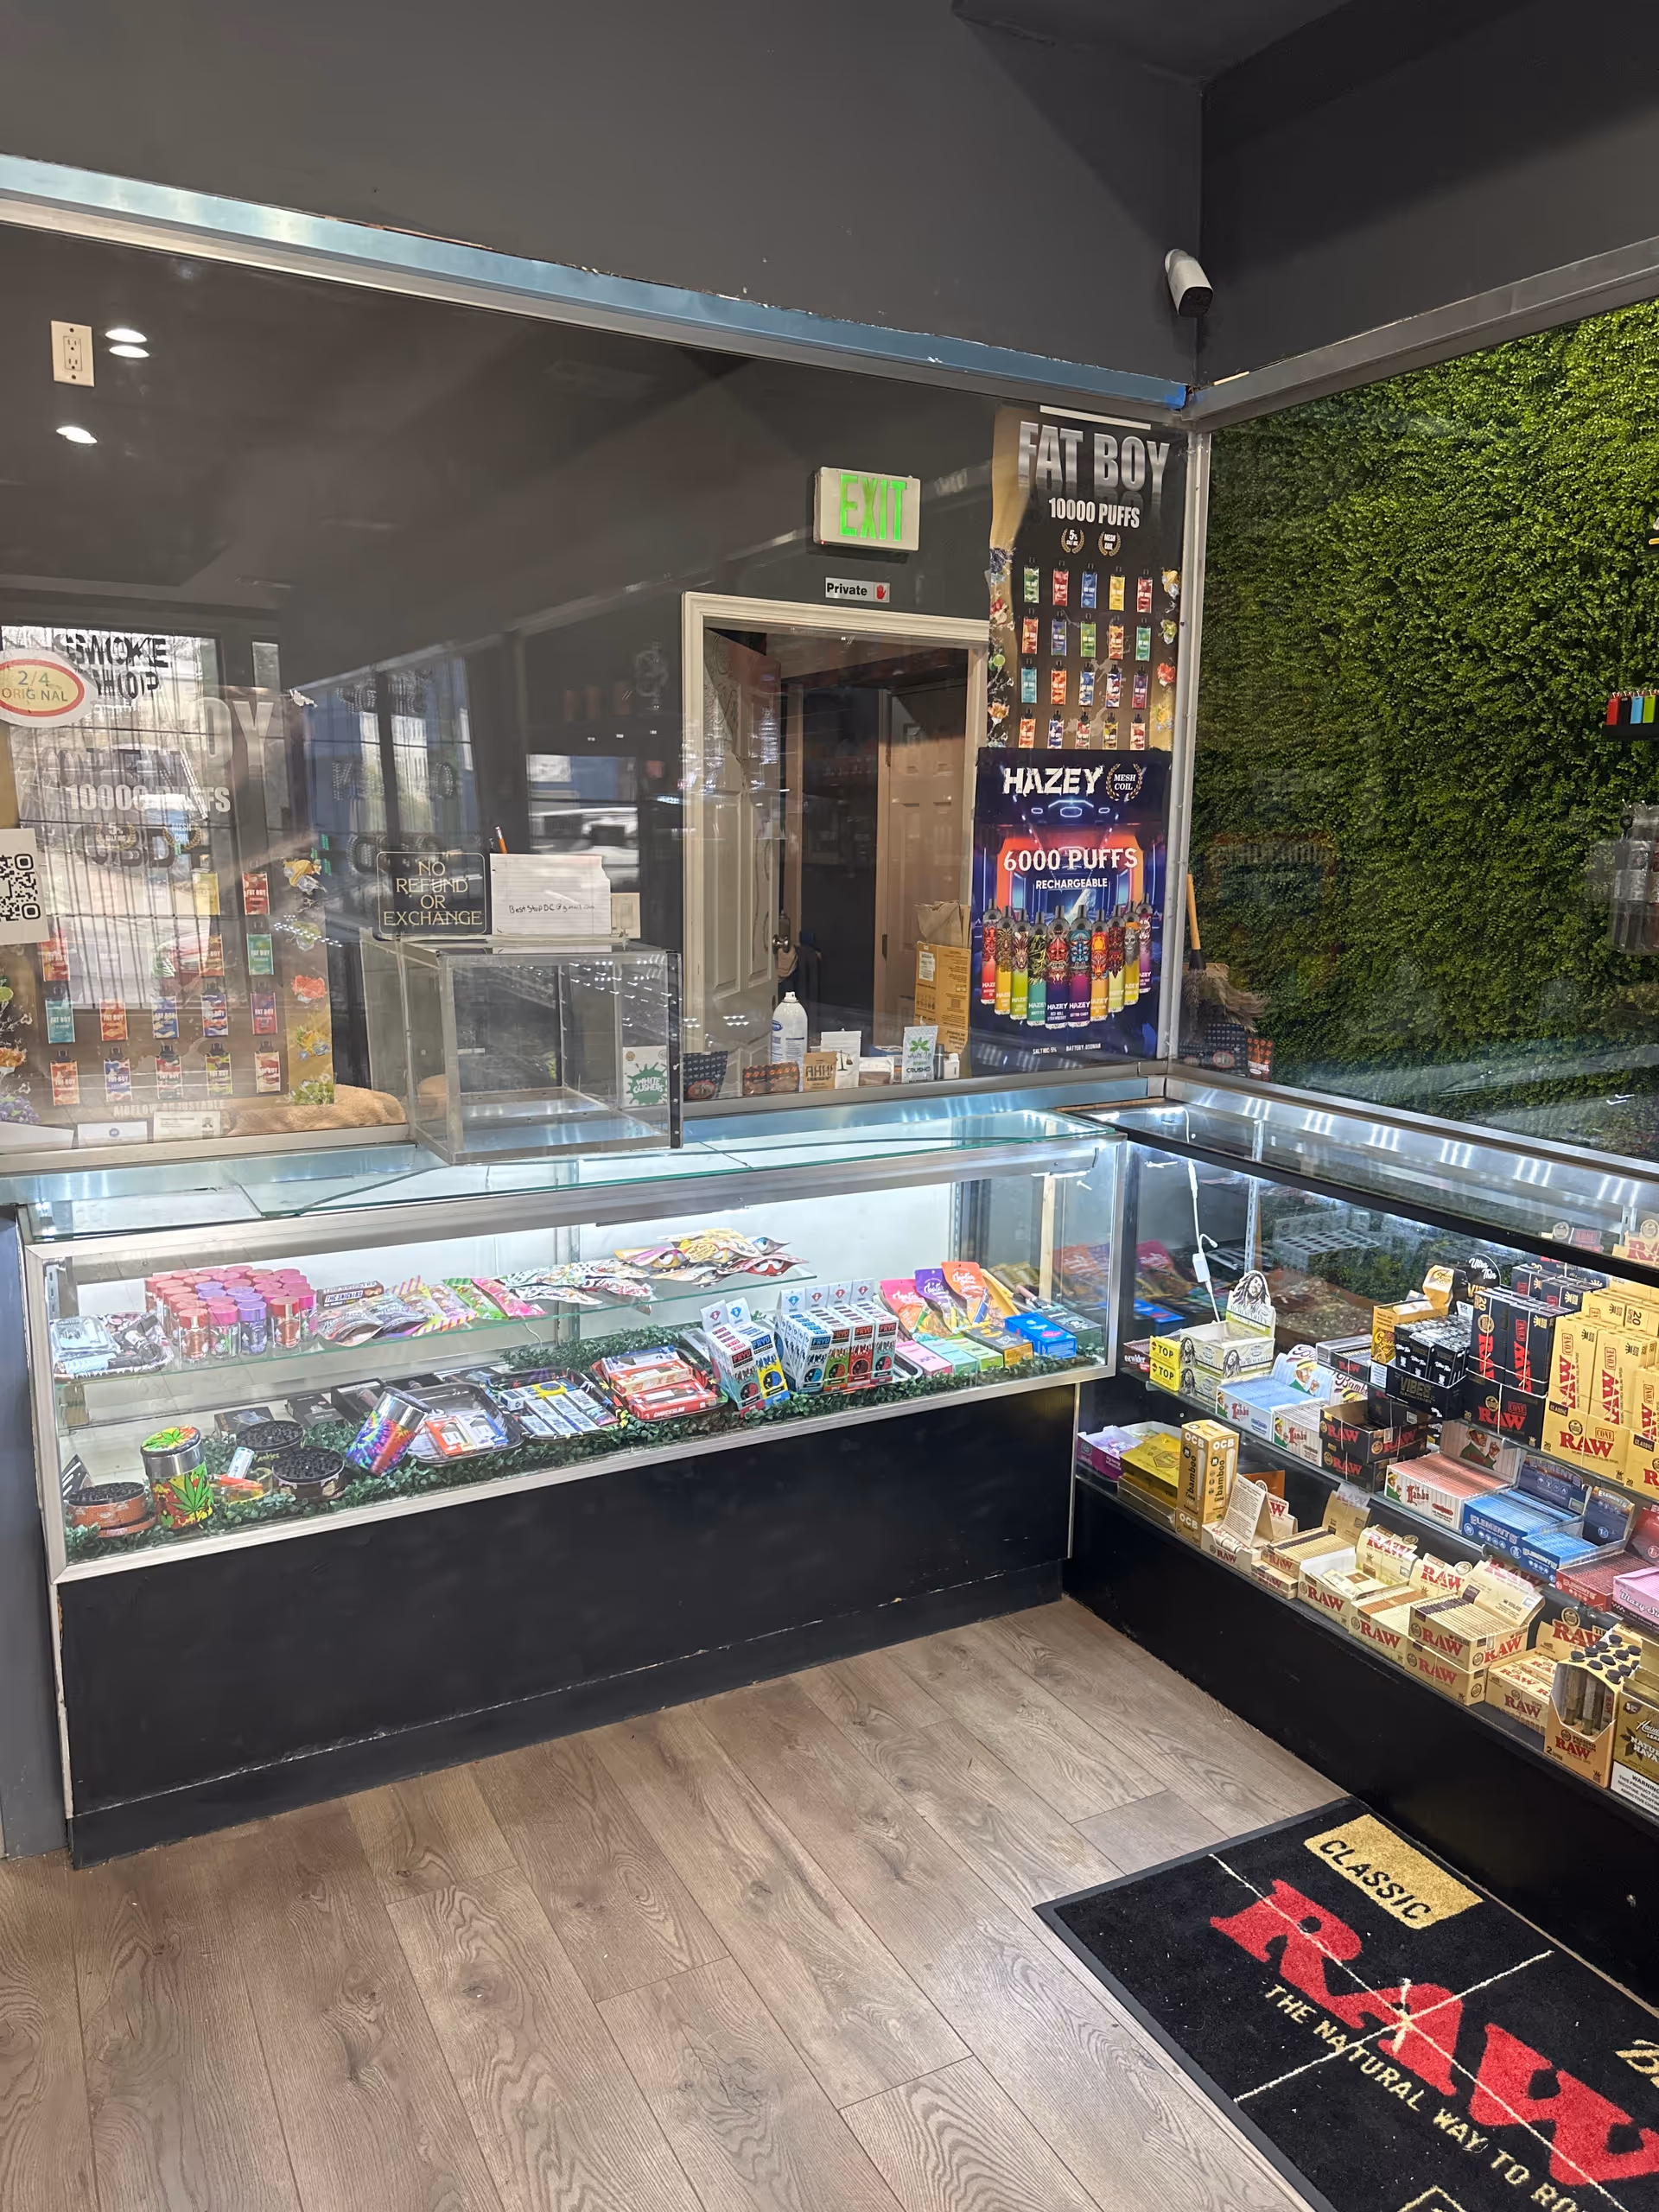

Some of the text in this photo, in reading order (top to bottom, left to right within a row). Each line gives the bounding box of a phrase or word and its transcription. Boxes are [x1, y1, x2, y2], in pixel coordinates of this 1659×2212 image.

[1017, 421, 1171, 493] FAT BOY
[839, 474, 907, 541] EXIT
[1048, 497, 1140, 528] 10000 PUFFS
[826, 581, 868, 596] Private
[18, 670, 50, 686] 2/4
[2, 688, 68, 702] ORIGNAL
[1002, 765, 1103, 796] HAZEY
[1113, 772, 1136, 784] MESH
[1114, 781, 1134, 792] COIL
[418, 861, 446, 877] NO
[1003, 847, 1139, 872] 6000 PUFFS
[396, 878, 468, 893] REFUND
[1035, 877, 1108, 890] RECHARGEABLE
[421, 894, 446, 909] OR
[383, 910, 483, 925] EXCHANGE
[1069, 1001, 1090, 1009] HAZEY
[633, 1083, 664, 1093] GUSHERS
[636, 1076, 662, 1085] WHITE
[752, 1335, 772, 1349] FRYD
[813, 1337, 830, 1345] FRYD
[1158, 1344, 1174, 1357] TOP
[733, 1350, 752, 1363] FRYD
[1606, 1348, 1615, 1369] CONE
[1159, 1366, 1174, 1380] TOP
[1400, 1376, 1432, 1398] VIBES
[1478, 1406, 1526, 1431] RAW
[1185, 1432, 1205, 1448] OCB
[1327, 1425, 1360, 1444] RAW
[1596, 1428, 1613, 1440] CONE
[1213, 1438, 1235, 1451] OCB
[1560, 1431, 1613, 1458] RAW
[1188, 1455, 1197, 1493] bamboo
[1332, 1456, 1363, 1475] RAW
[1217, 1460, 1225, 1497] bamboo
[1179, 1515, 1198, 1530] OCB
[1470, 1514, 1518, 1544] ELEMENTS
[1217, 1549, 1237, 1564] RAW
[1367, 1536, 1414, 1558] RAW
[1269, 1554, 1293, 1571] RAW
[1522, 1548, 1559, 1570] ELEMENTS
[1421, 1565, 1464, 1591] RAW
[1307, 1585, 1345, 1611] RAW
[1562, 1580, 1597, 1600] ELEMENTS
[1620, 1589, 1645, 1611] Blazy
[1360, 1621, 1401, 1649] RAW
[1422, 1627, 1464, 1656] RAW
[1484, 1635, 1523, 1663] RAW
[1418, 1657, 1458, 1685] RAW
[1500, 1669, 1536, 1686] RAW
[1504, 1694, 1541, 1719] RAW
[1555, 1736, 1591, 1759] RAW
[1319, 1840, 1432, 1920] CLASSIC
[1211, 1878, 1659, 2185] RAW
[1265, 1984, 1319, 2025] THE
[1313, 2019, 1425, 2112] NATURAL
[1433, 2108, 1489, 2152] WAY
[1490, 2148, 1530, 2185] TO
